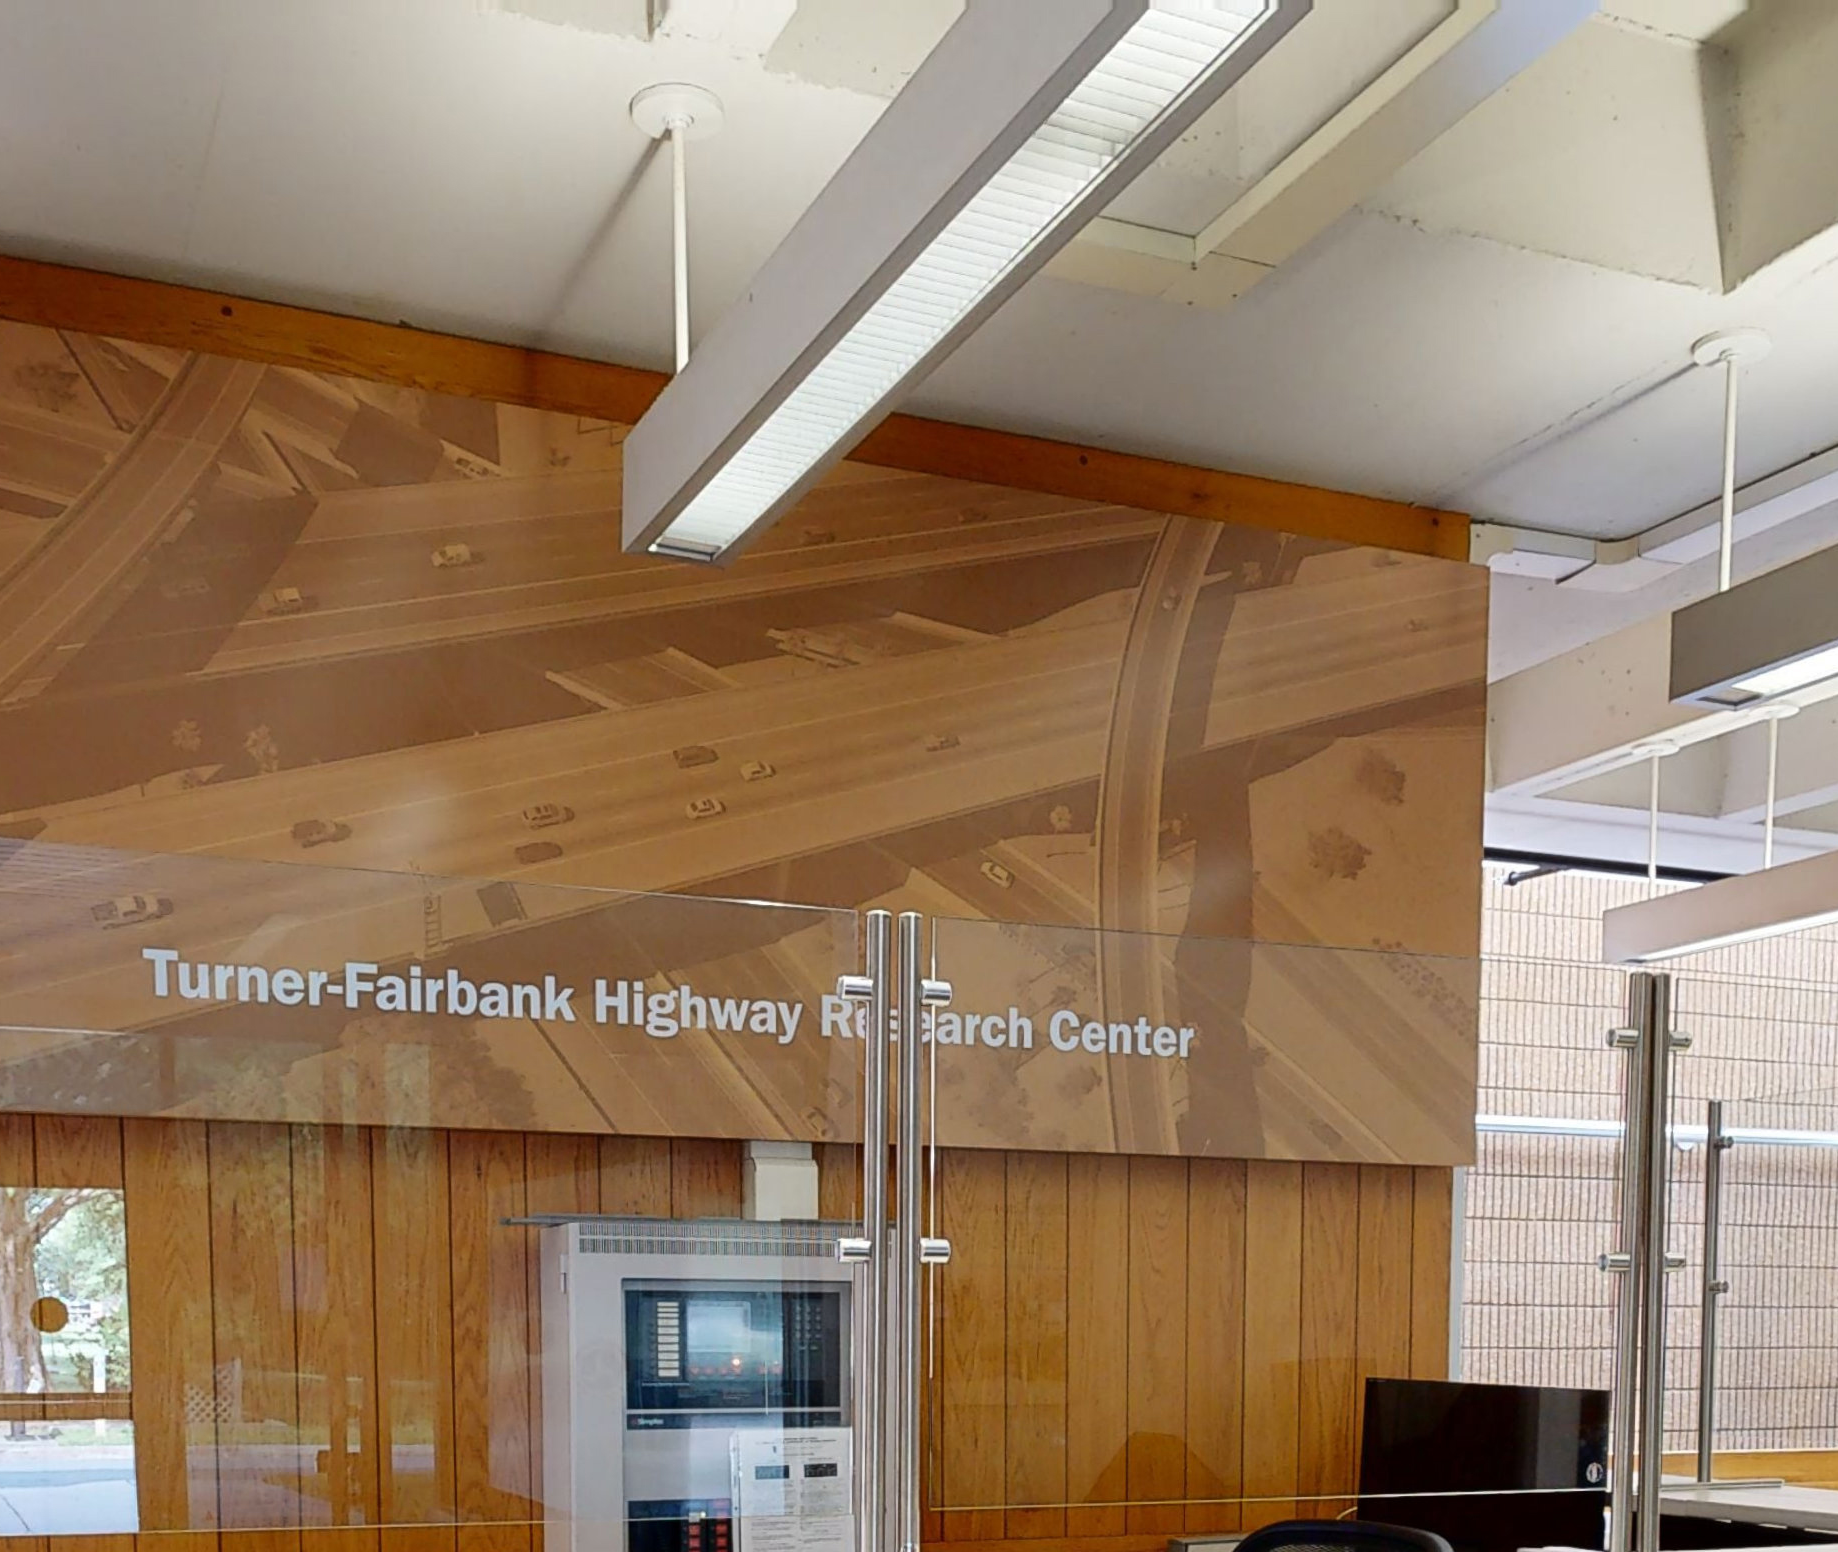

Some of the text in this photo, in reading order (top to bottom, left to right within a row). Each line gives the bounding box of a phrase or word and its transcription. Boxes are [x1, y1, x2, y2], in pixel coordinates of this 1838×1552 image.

[142, 947, 576, 1022] Turner-Fairbank
[595, 979, 803, 1045] Highway
[1049, 1010, 1195, 1059] Center
